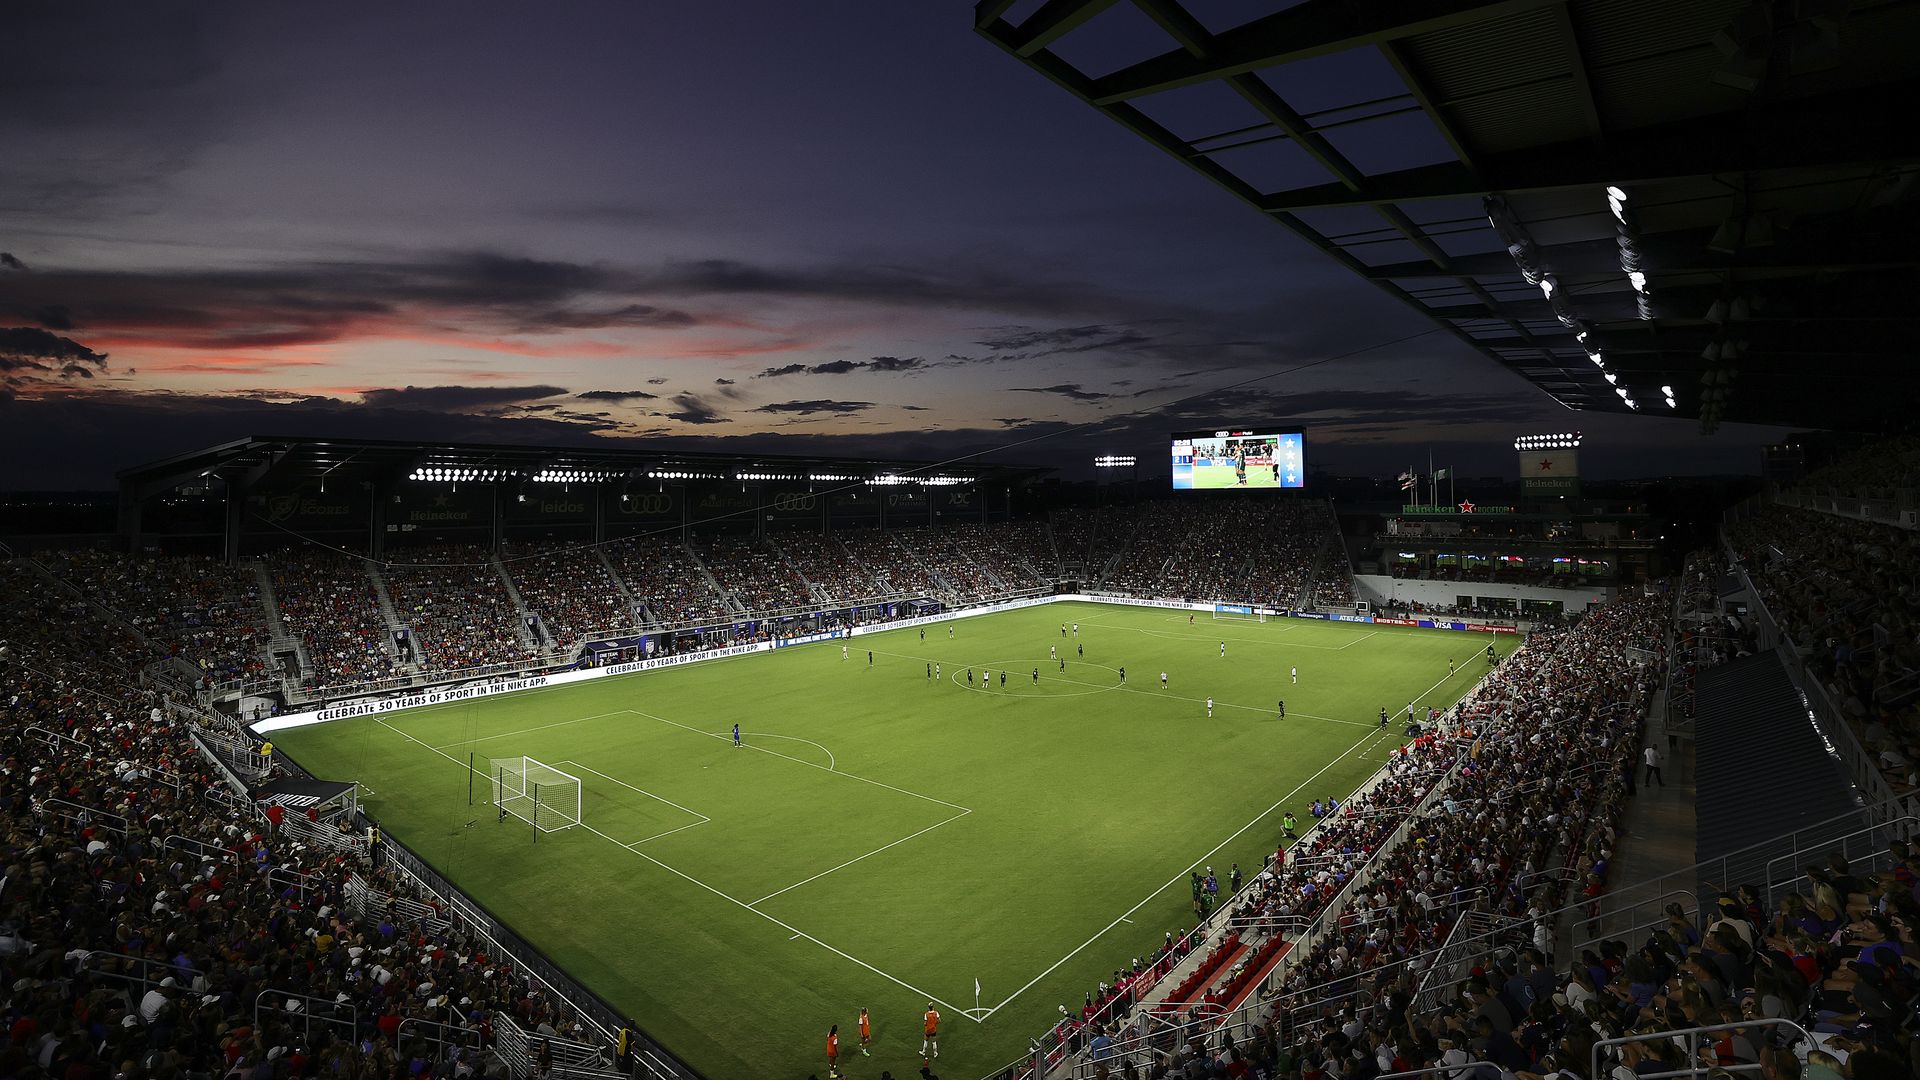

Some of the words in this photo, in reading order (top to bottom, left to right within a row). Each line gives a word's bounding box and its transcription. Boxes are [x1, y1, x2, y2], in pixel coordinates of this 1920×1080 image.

[1525, 480, 1571, 488] Heineken
[540, 501, 585, 513] leidos
[1402, 504, 1456, 514] Heineken
[410, 511, 468, 520] Heineken
[863, 624, 886, 633] CELEBRATE
[894, 620, 907, 628] YEARS
[914, 617, 926, 625] SPORT
[1433, 621, 1452, 629] VISA
[606, 663, 643, 674] CELEBRATE
[657, 656, 677, 666] YEARS
[690, 652, 709, 661] SPORT
[720, 648, 730, 656] THE
[732, 646, 745, 654] NIKE
[747, 644, 759, 652] APP.
[317, 704, 374, 721] CELEBRATE
[379, 701, 392, 711] 50
[395, 696, 426, 708] YEARS
[430, 693, 441, 703] OF
[445, 688, 474, 701] SPORT
[477, 687, 486, 695] IN
[490, 683, 505, 693] THE
[507, 680, 527, 690] NIKE
[530, 677, 548, 687] APP.
